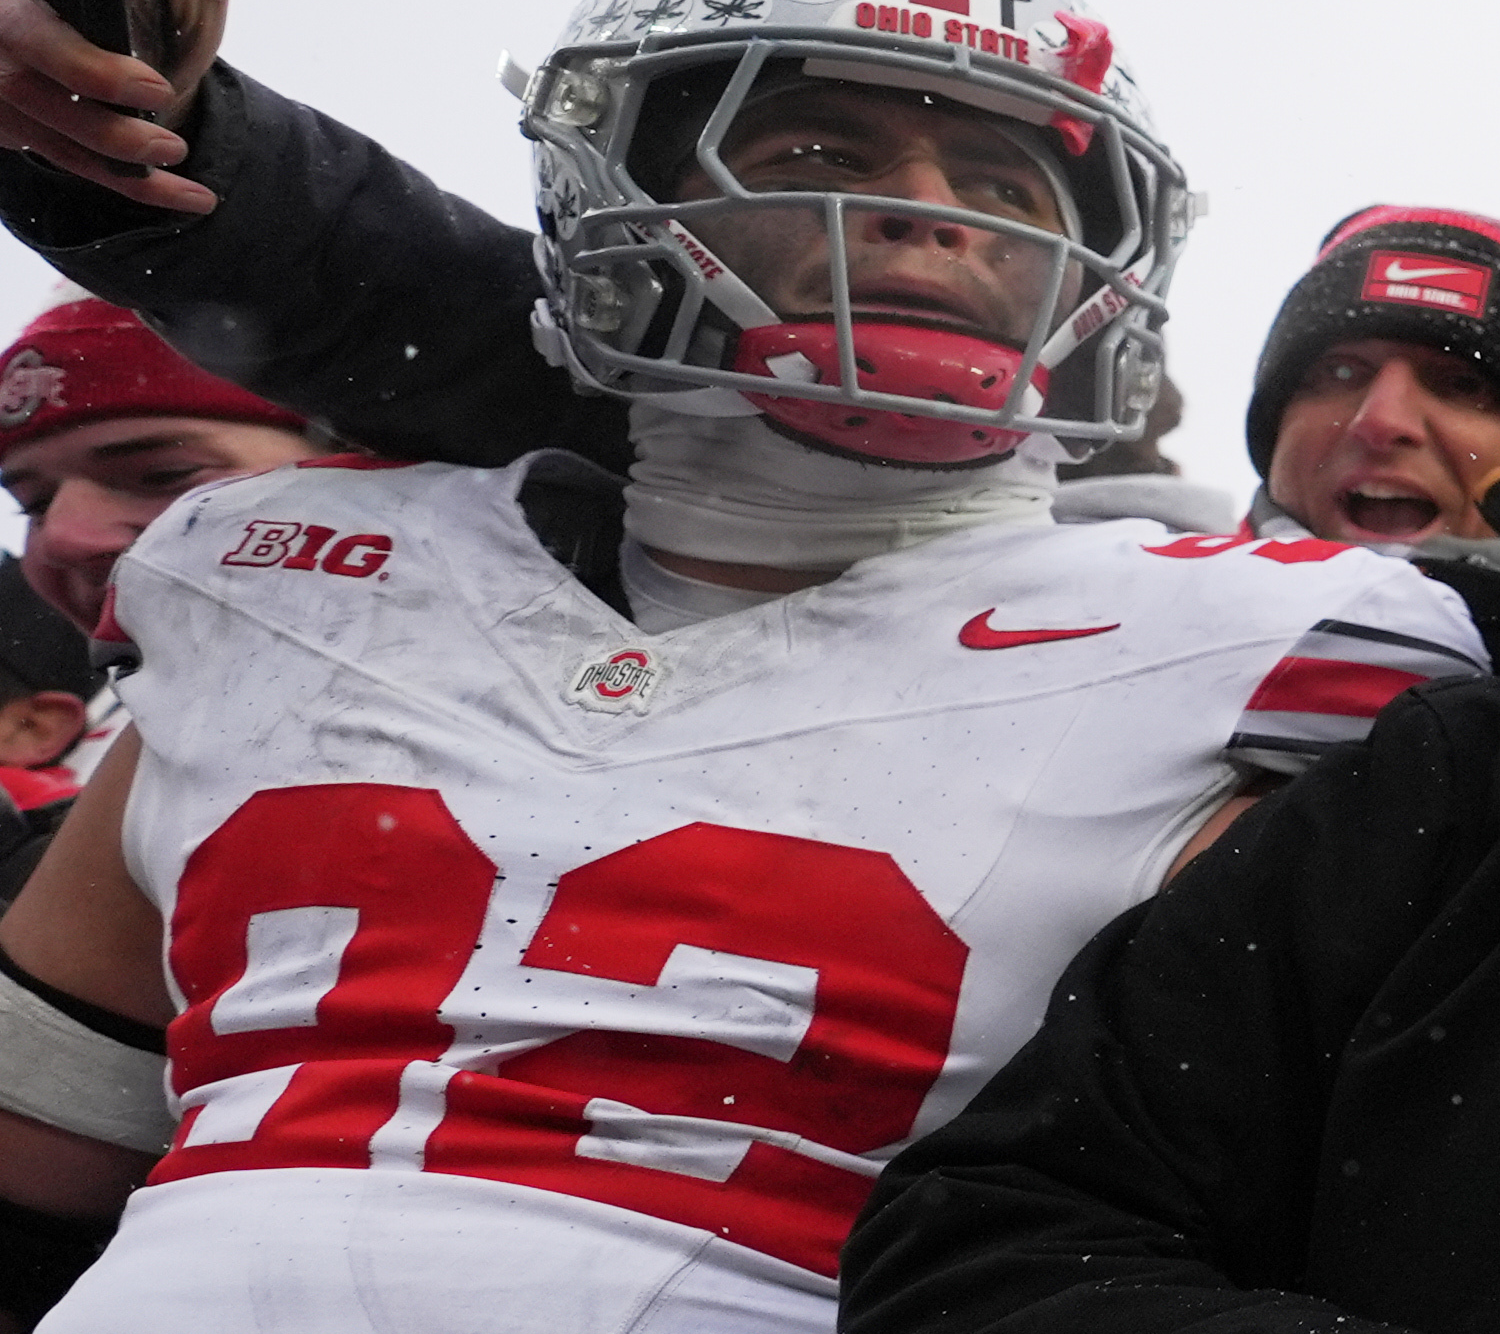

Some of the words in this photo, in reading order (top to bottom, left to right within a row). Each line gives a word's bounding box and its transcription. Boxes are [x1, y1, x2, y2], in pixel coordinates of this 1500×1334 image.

[856, 2, 932, 39] OHIO
[944, 18, 1030, 65] STATE
[147, 782, 970, 1279] 92
